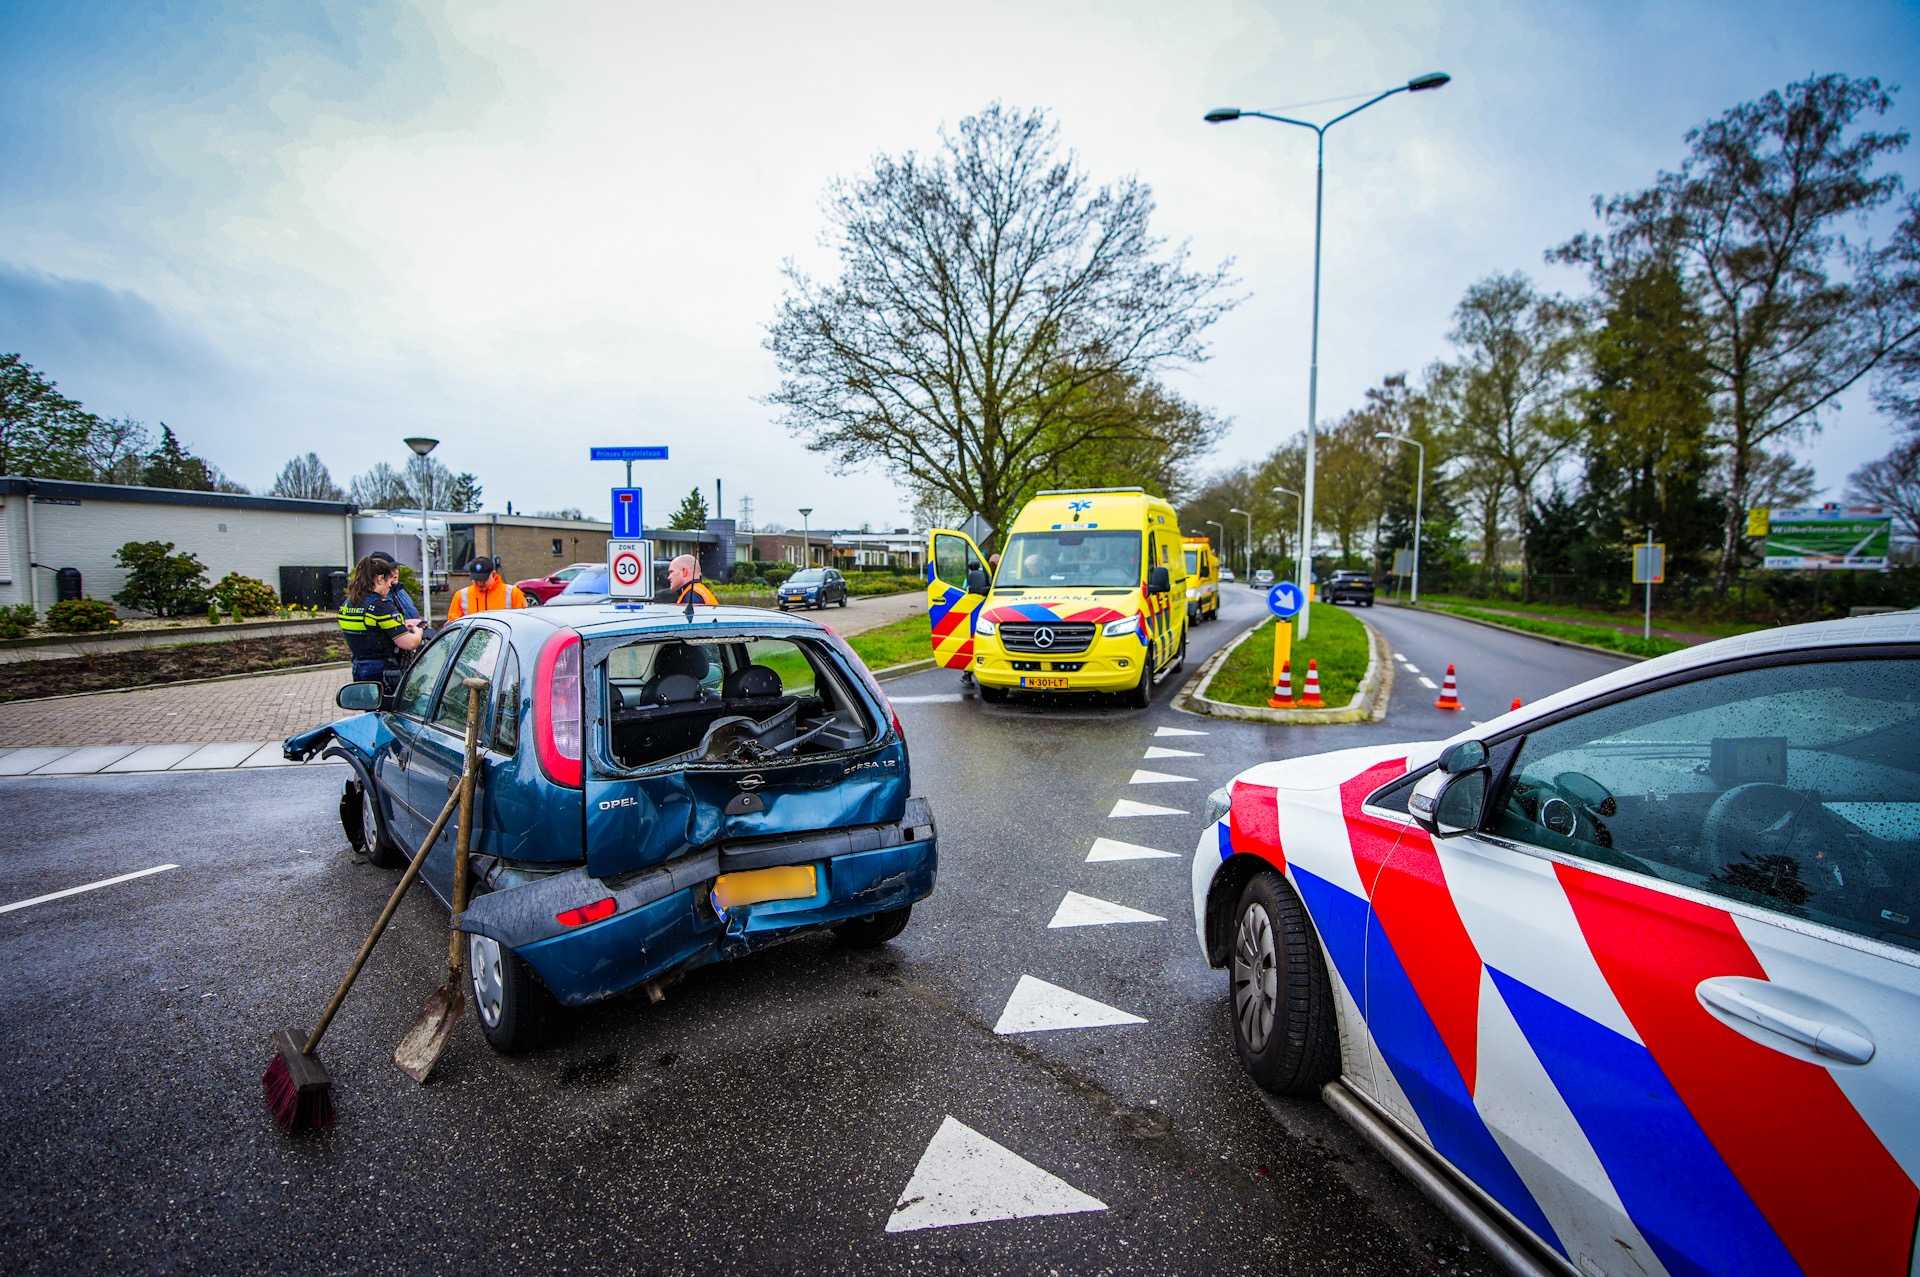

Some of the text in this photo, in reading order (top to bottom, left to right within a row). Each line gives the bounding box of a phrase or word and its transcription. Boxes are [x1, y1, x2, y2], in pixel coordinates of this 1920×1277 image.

[596, 449, 661, 458] Prinses Beatrixlaan
[1771, 524, 1849, 534] Wilhelmina
[618, 563, 637, 575] 30
[1029, 678, 1064, 687] N-301-LT
[843, 761, 880, 774] CORSA
[598, 797, 639, 811] OPEL
